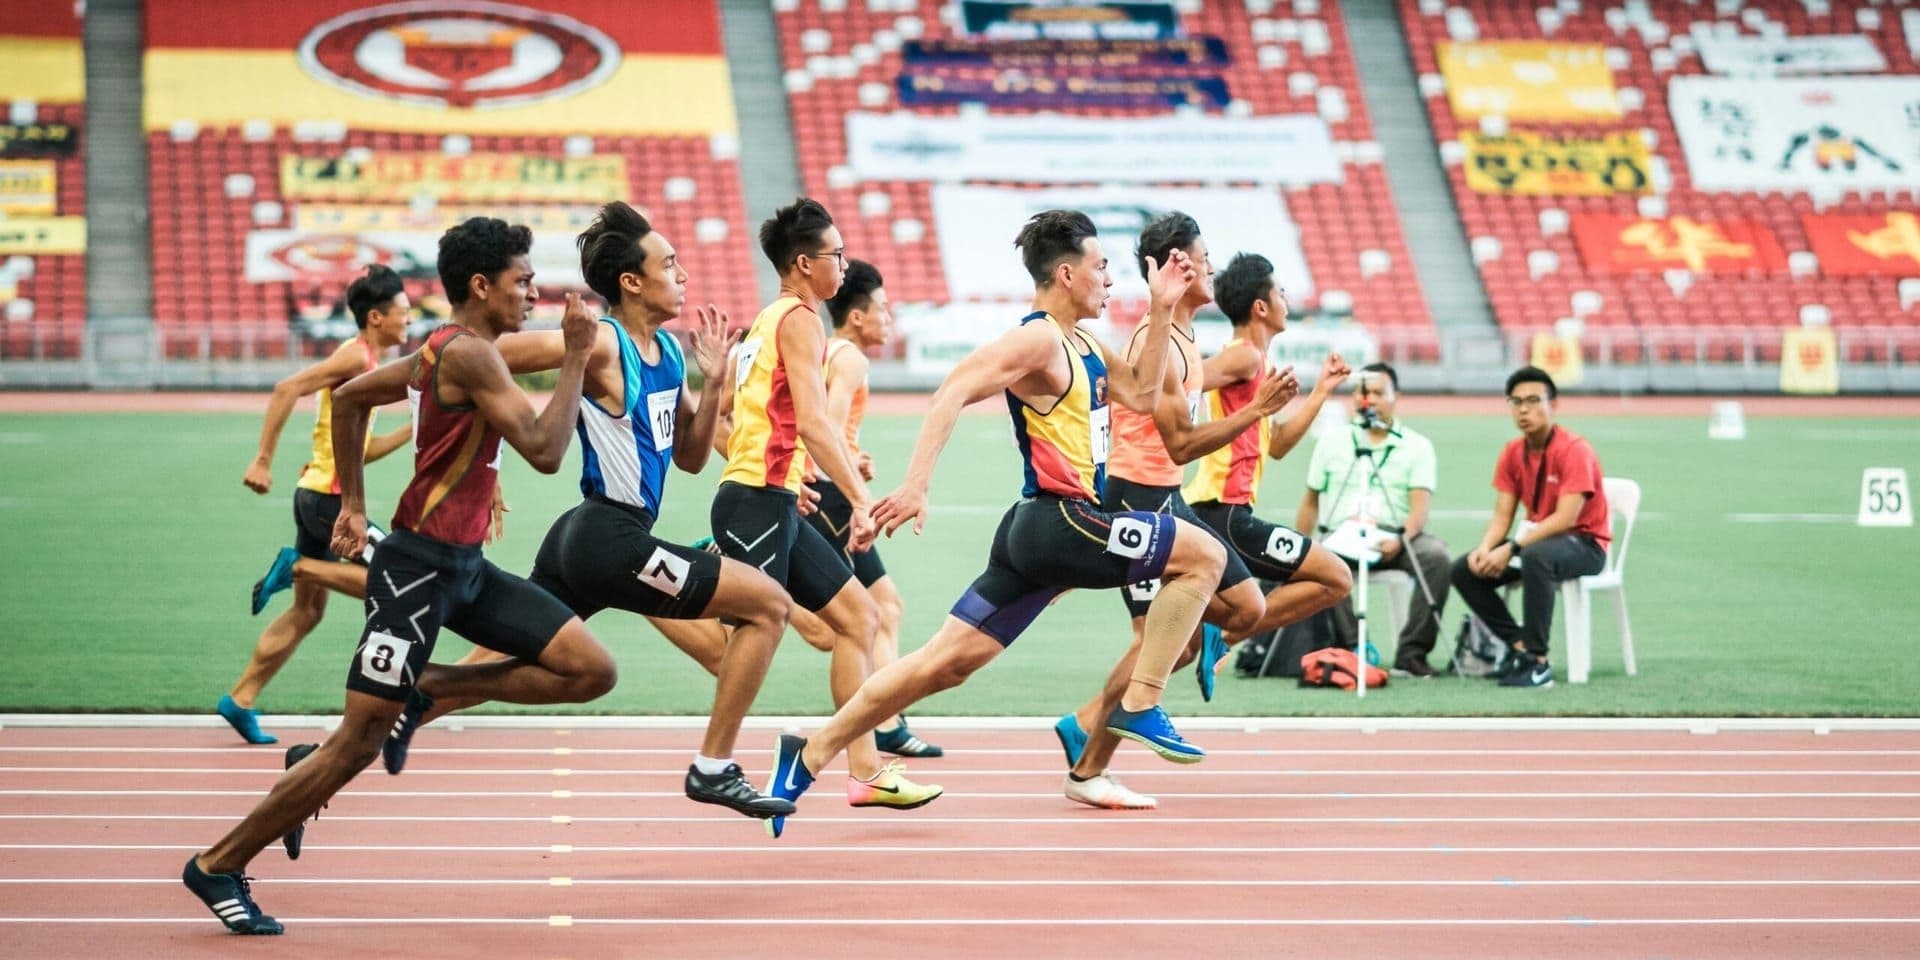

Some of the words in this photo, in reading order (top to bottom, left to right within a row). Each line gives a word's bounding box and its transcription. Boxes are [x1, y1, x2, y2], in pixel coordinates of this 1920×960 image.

[1868, 478, 1902, 514] 55
[1118, 526, 1142, 549] 6
[1276, 537, 1294, 554] 3
[650, 559, 678, 583] 7
